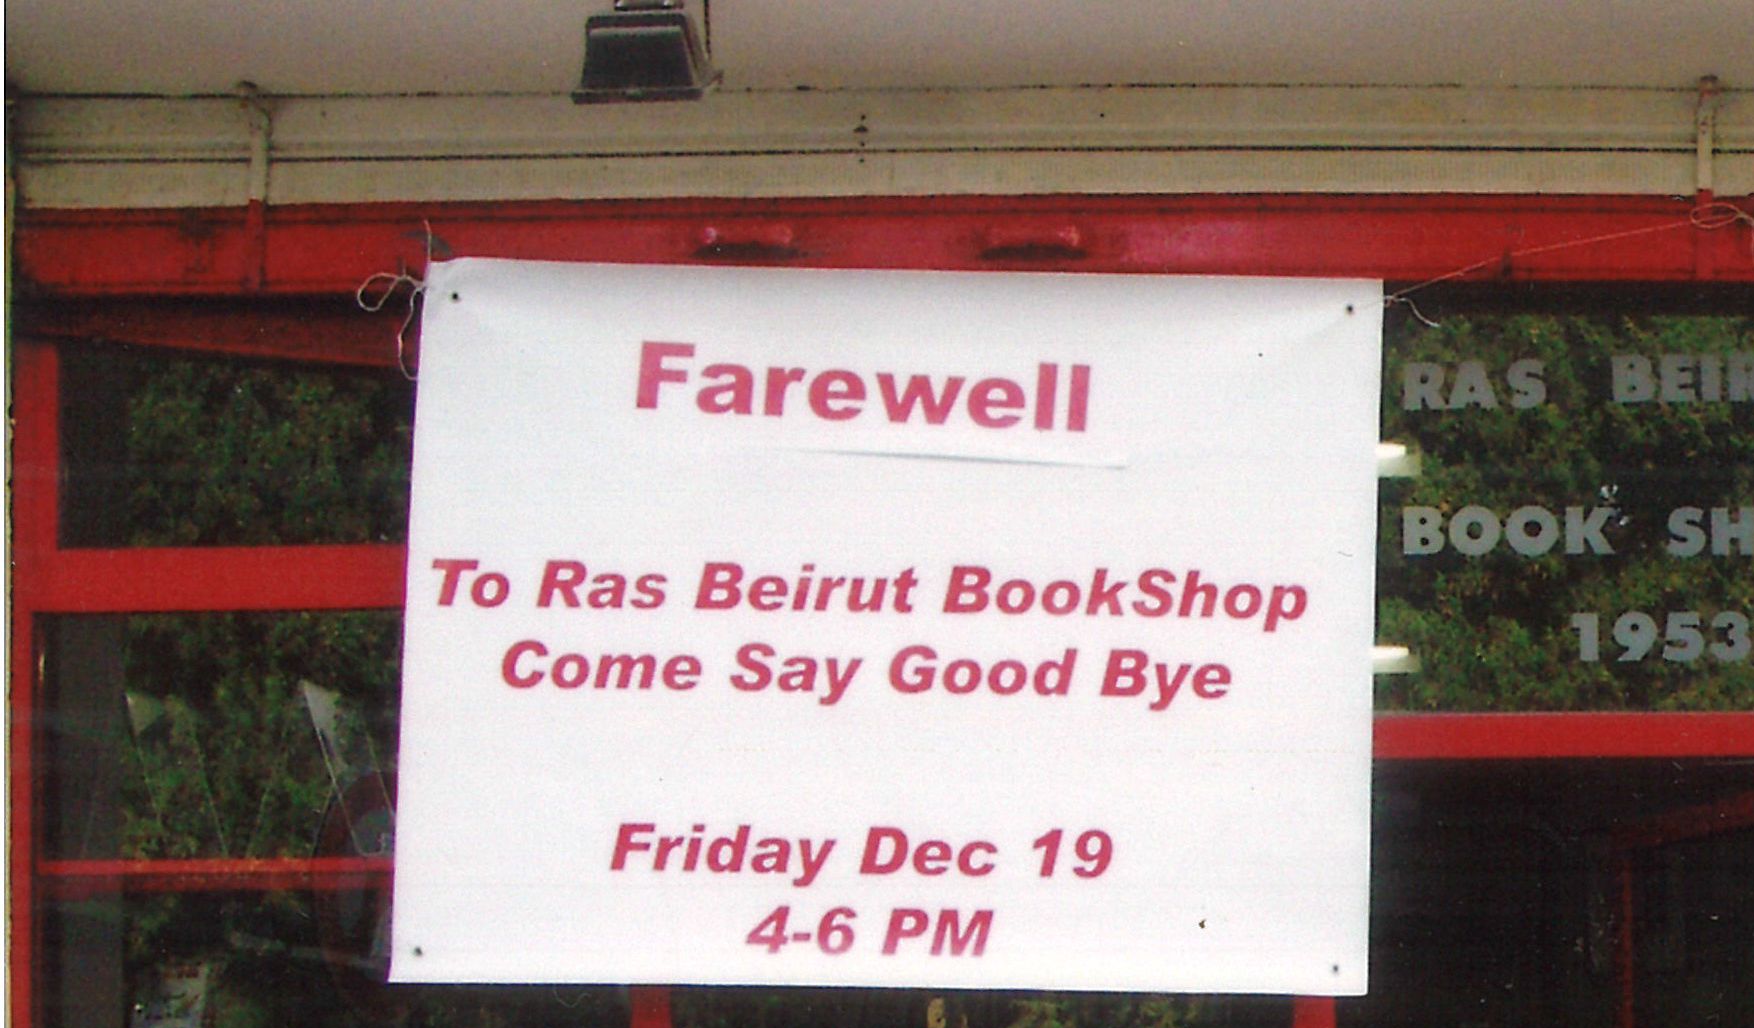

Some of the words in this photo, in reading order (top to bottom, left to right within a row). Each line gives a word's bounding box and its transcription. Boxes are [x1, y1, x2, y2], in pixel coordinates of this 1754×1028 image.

[637, 342, 1090, 432] Farewell
[1403, 360, 1548, 411] RAS
[1402, 506, 1616, 558] BOOK
[432, 559, 511, 609] To
[538, 560, 667, 610] Ras
[695, 562, 918, 615] Beirut
[943, 565, 1308, 634] BookShop
[1570, 611, 1752, 663] 1953
[501, 640, 702, 691] Come
[730, 642, 861, 706] Say
[889, 645, 1078, 697] Good
[1100, 649, 1232, 712] Bye
[611, 822, 836, 889] Friday
[859, 826, 997, 878] Dec
[1034, 828, 1114, 880] 19
[747, 905, 856, 955] 4-6
[883, 907, 994, 956] PM
